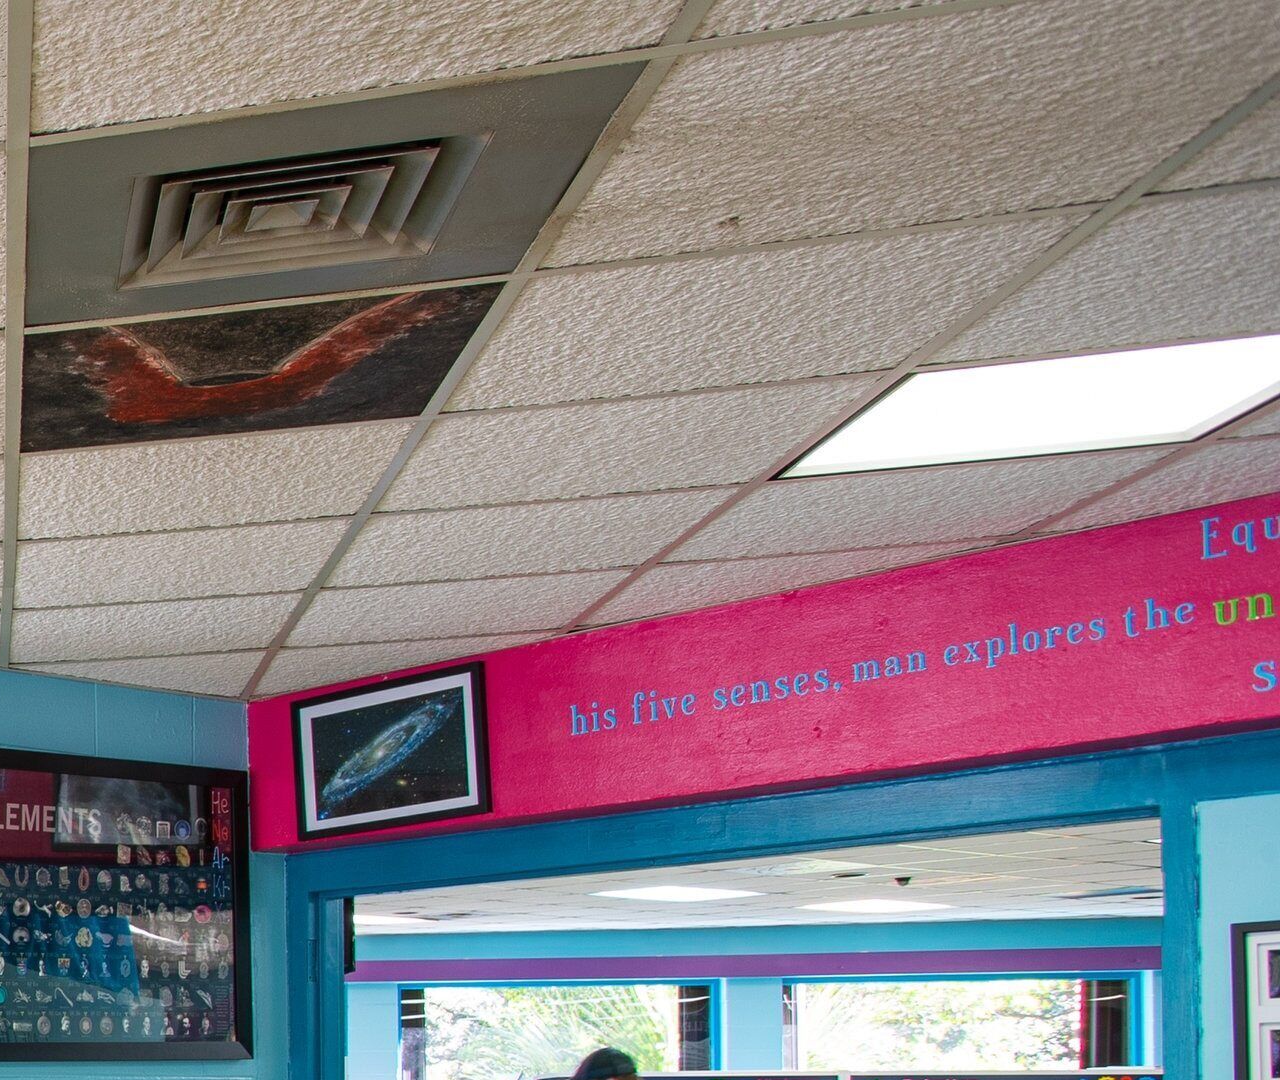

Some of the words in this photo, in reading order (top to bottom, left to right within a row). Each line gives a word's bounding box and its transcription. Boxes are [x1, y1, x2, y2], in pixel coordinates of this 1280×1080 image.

[570, 701, 617, 736] his
[630, 687, 697, 726] five
[712, 664, 842, 711] senses,
[852, 649, 927, 685] man
[943, 616, 1106, 671] explores
[1123, 598, 1195, 637] the
